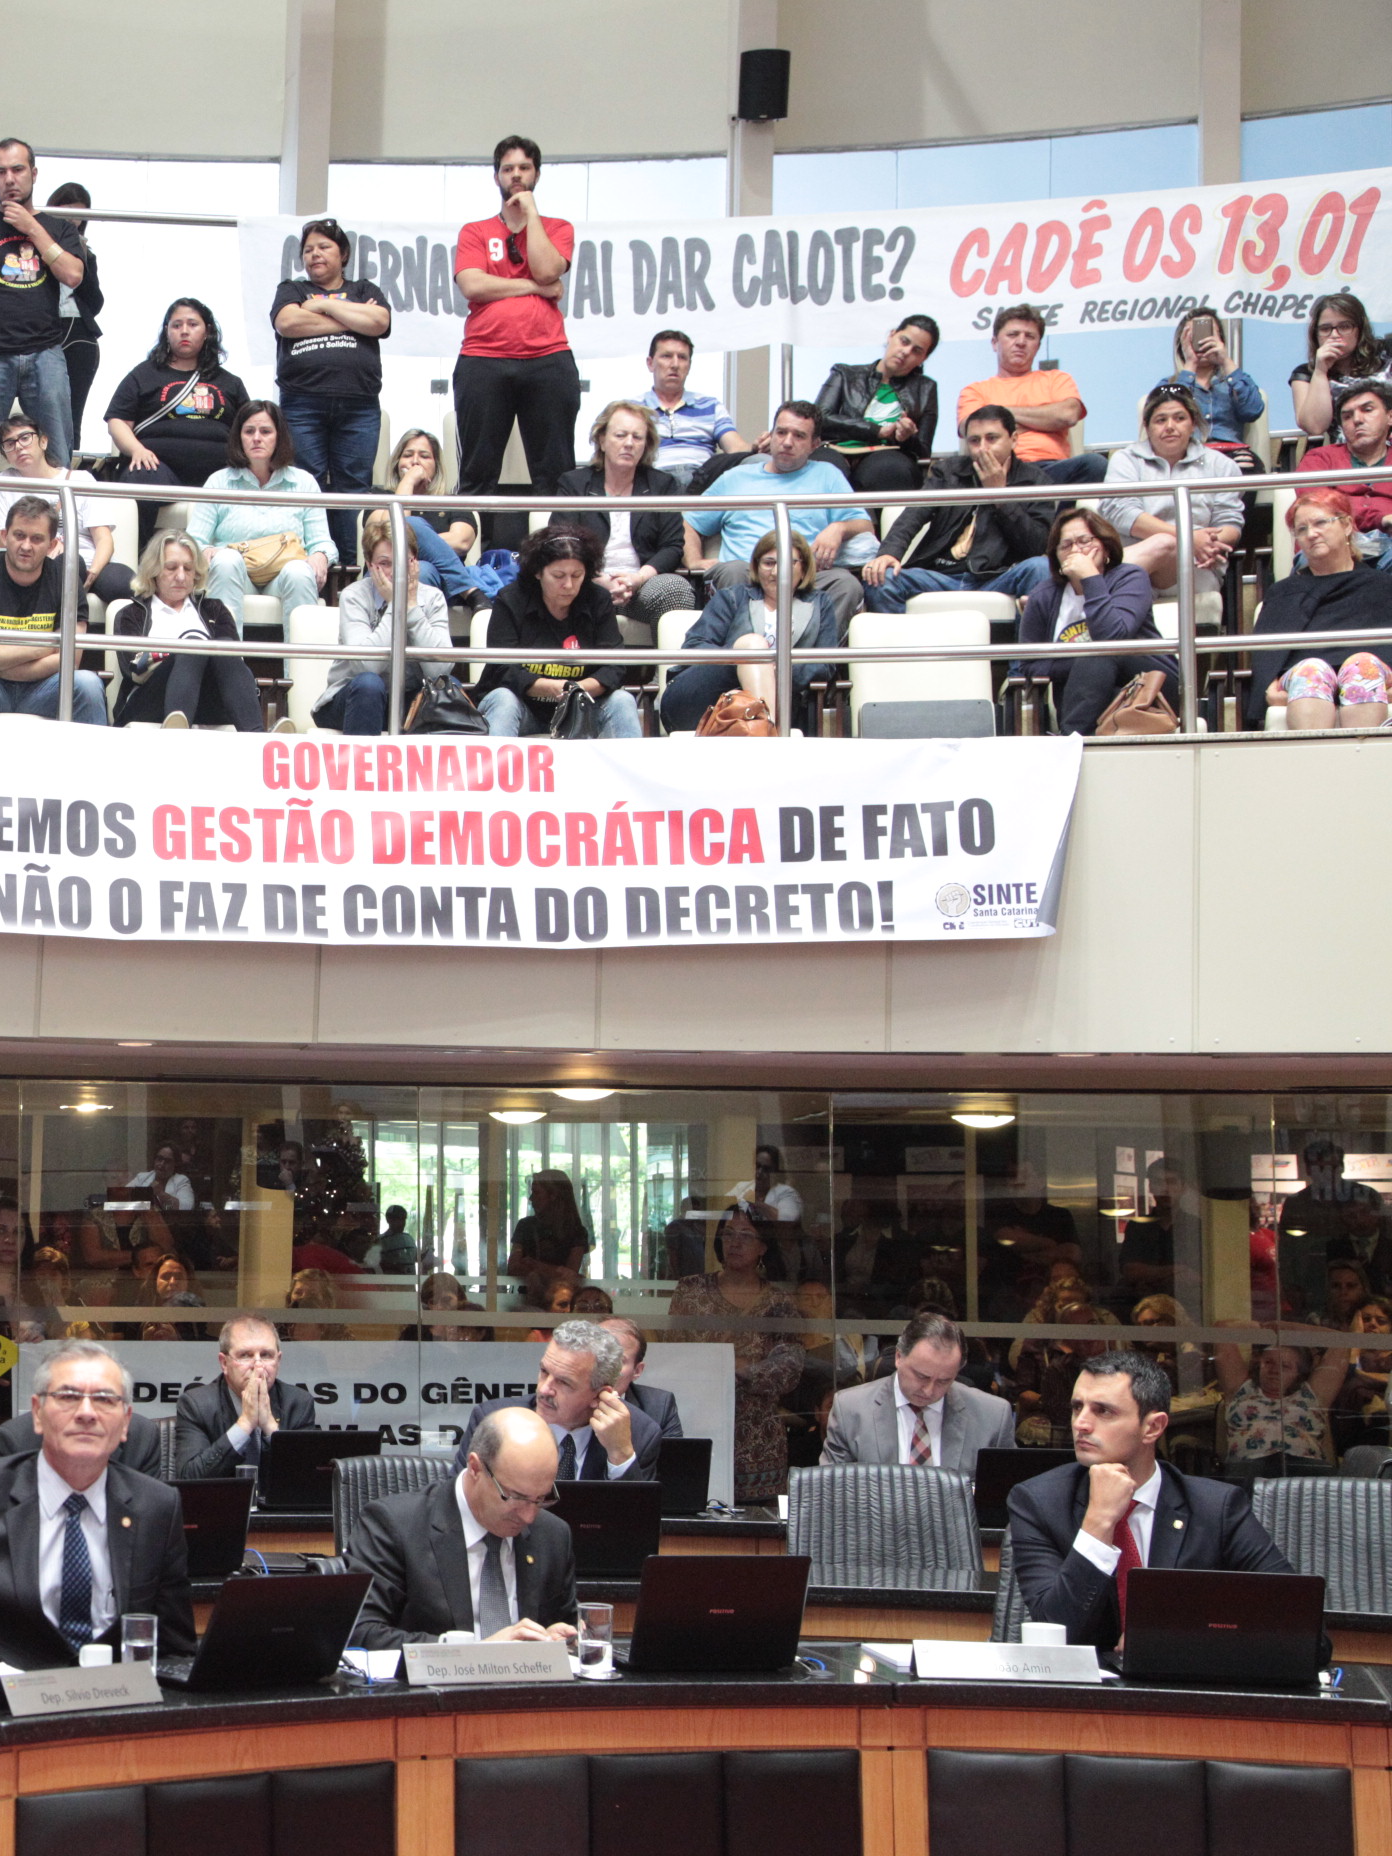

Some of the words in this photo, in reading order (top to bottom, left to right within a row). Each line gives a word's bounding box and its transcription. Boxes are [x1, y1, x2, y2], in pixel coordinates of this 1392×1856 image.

[489, 237, 504, 262] 9
[949, 199, 1112, 298] CADÊ
[1122, 203, 1202, 284] OS
[1216, 186, 1382, 292] 13,01
[632, 236, 716, 316] DAR
[732, 225, 917, 308] CALOTE?
[1223, 287, 1351, 320] CHAPE
[522, 663, 585, 678] OLOMBO!
[262, 740, 555, 792] GOVERNADOR
[152, 797, 354, 864] GESTÃO
[371, 801, 765, 868] DEMOCRÁTICA
[780, 805, 847, 863] DE
[863, 797, 995, 860] FATO
[972, 882, 1039, 906] SINTE
[108, 878, 144, 935] O
[159, 879, 249, 936] FAZ
[262, 884, 328, 939] DE
[342, 884, 521, 943] CONTA
[534, 886, 611, 944] DO
[625, 880, 896, 941] DECRETO!
[973, 908, 998, 918] Santa
[1001, 906, 1040, 917] Catarina
[353, 1382, 407, 1405] DO
[381, 1424, 422, 1446] AS
[427, 1665, 451, 1679] Dep.
[454, 1663, 475, 1676] José
[478, 1662, 510, 1675] Milton
[514, 1661, 552, 1674] Scheffer
[995, 1663, 1018, 1673] oão
[1023, 1663, 1052, 1674] Amin
[41, 1692, 63, 1706] Dep.
[65, 1688, 91, 1700] Silvio
[93, 1685, 130, 1699] Dreveck
